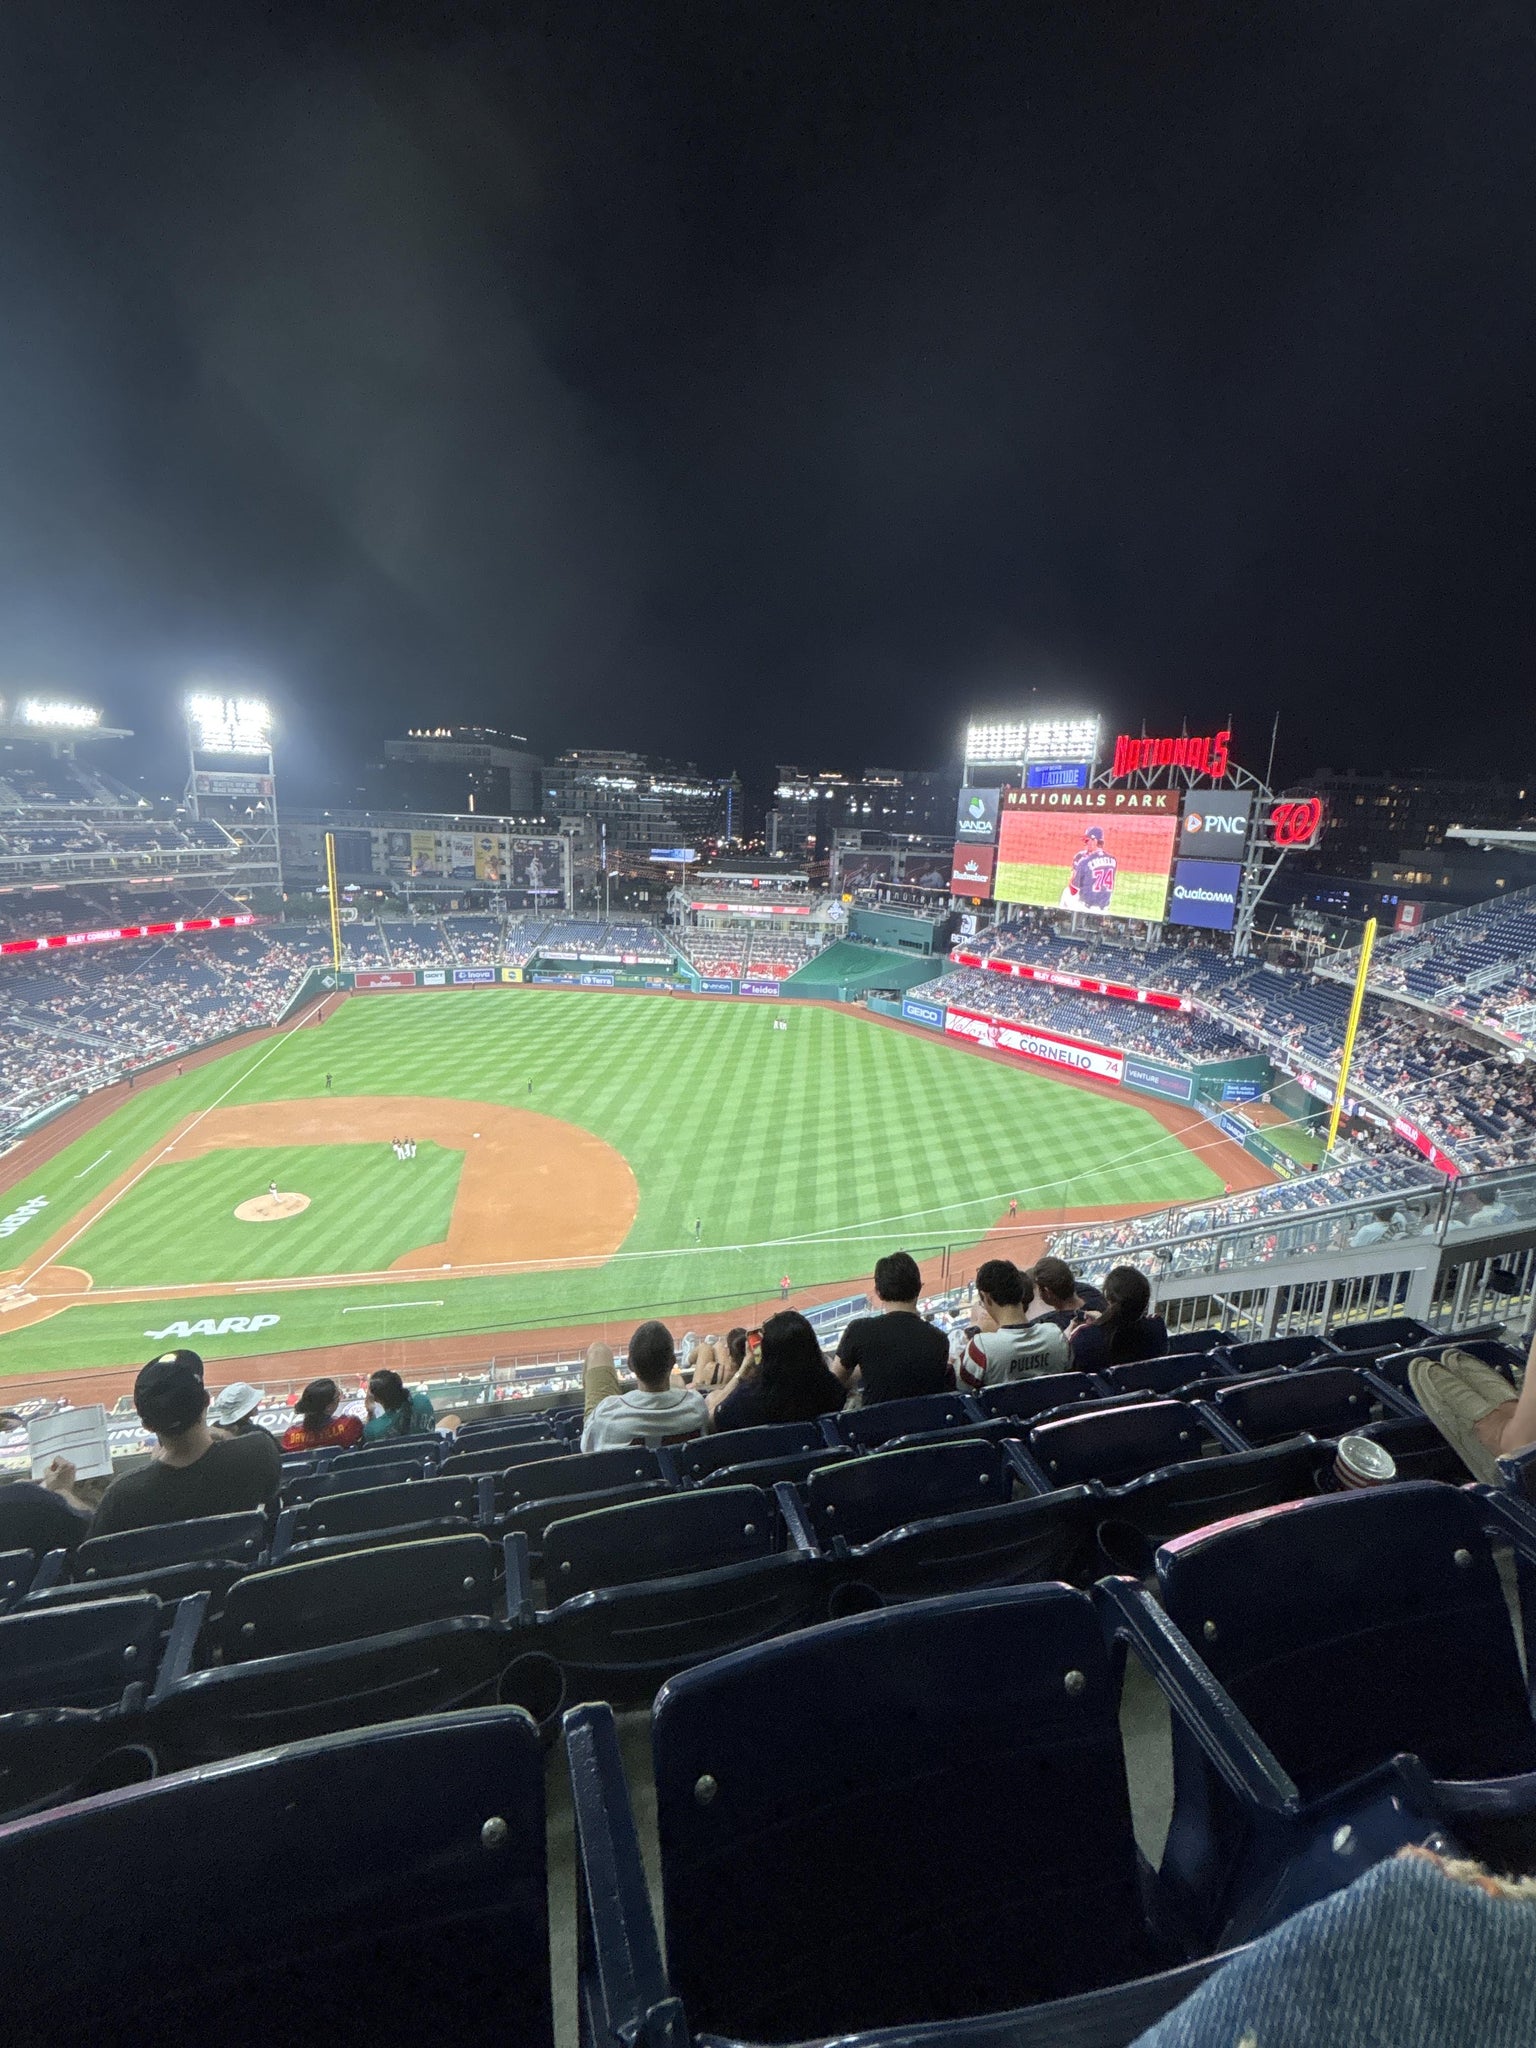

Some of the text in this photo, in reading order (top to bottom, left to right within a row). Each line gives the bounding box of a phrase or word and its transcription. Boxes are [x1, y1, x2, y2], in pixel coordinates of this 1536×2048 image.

[1113, 731, 1230, 778] NATIONALS
[1007, 792, 1167, 808] NATIONALS PARK
[959, 820, 993, 831] VANDA
[1204, 815, 1247, 835] PNC
[953, 870, 989, 883] Budweiser
[1092, 868, 1114, 892] 74
[1174, 885, 1234, 904] Qualcomm
[592, 977, 612, 986] Terra
[752, 985, 778, 995] leidos
[907, 1005, 938, 1021] GEICO
[1019, 1039, 1092, 1069] CORNELIO
[1105, 1060, 1118, 1074] 74
[1129, 1069, 1160, 1084] VENTURE
[143, 1314, 281, 1340] AARP
[1010, 1352, 1049, 1373] PULISIC
